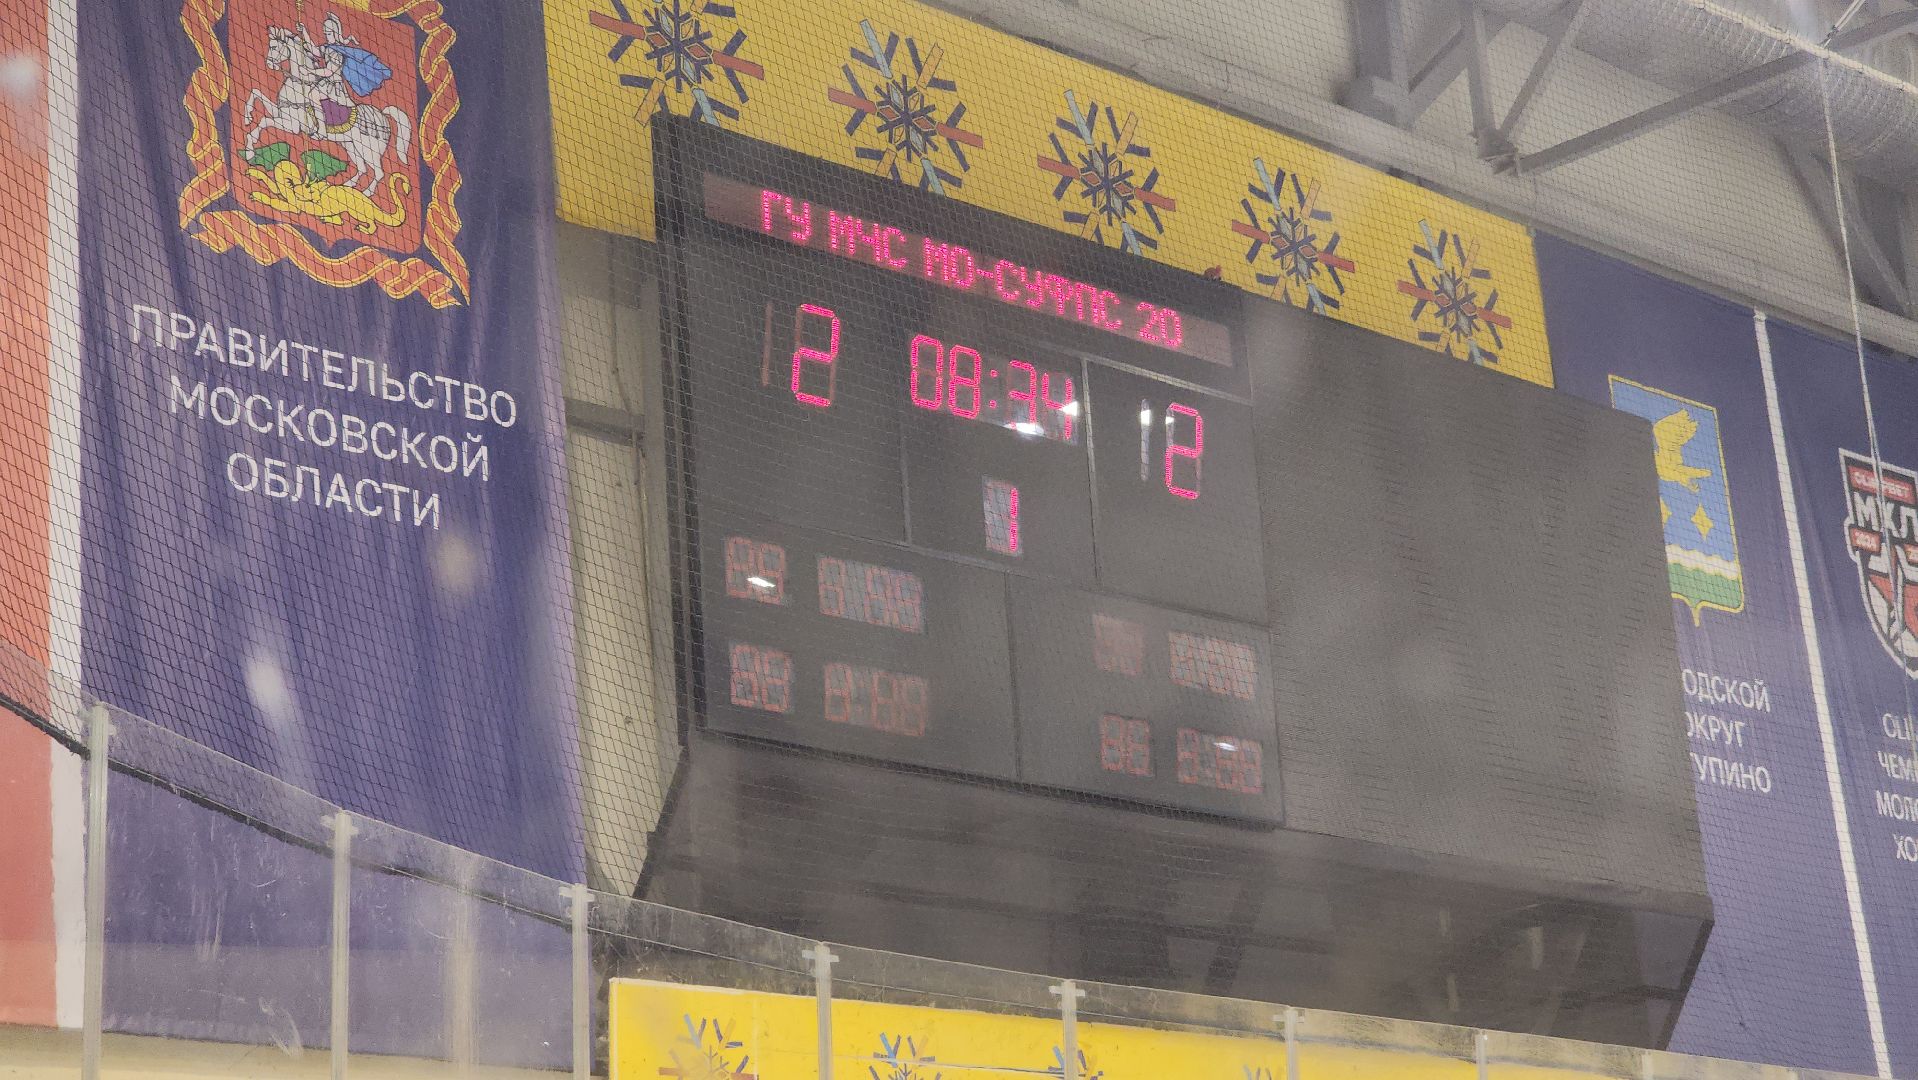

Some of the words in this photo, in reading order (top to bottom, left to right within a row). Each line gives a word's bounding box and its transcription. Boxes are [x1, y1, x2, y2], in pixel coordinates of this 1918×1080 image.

[761, 189, 812, 242] ГУ
[829, 209, 908, 269] МЧС
[1136, 301, 1183, 348] 20
[131, 303, 517, 428] ПРАВИТЕЛЬСТВО
[791, 303, 841, 407] 2
[909, 334, 1075, 441] 08:34
[169, 374, 490, 482] МОСКОВСКОЙ
[226, 451, 441, 531] ОБЛАСТИ
[1681, 668, 1771, 713] ОДСКОЙ
[1689, 751, 1772, 793] УПИНО
[1876, 789, 1918, 822] МОЛ
[1877, 750, 1918, 782] ЧЕМ
[1892, 833, 1918, 862] ХО
